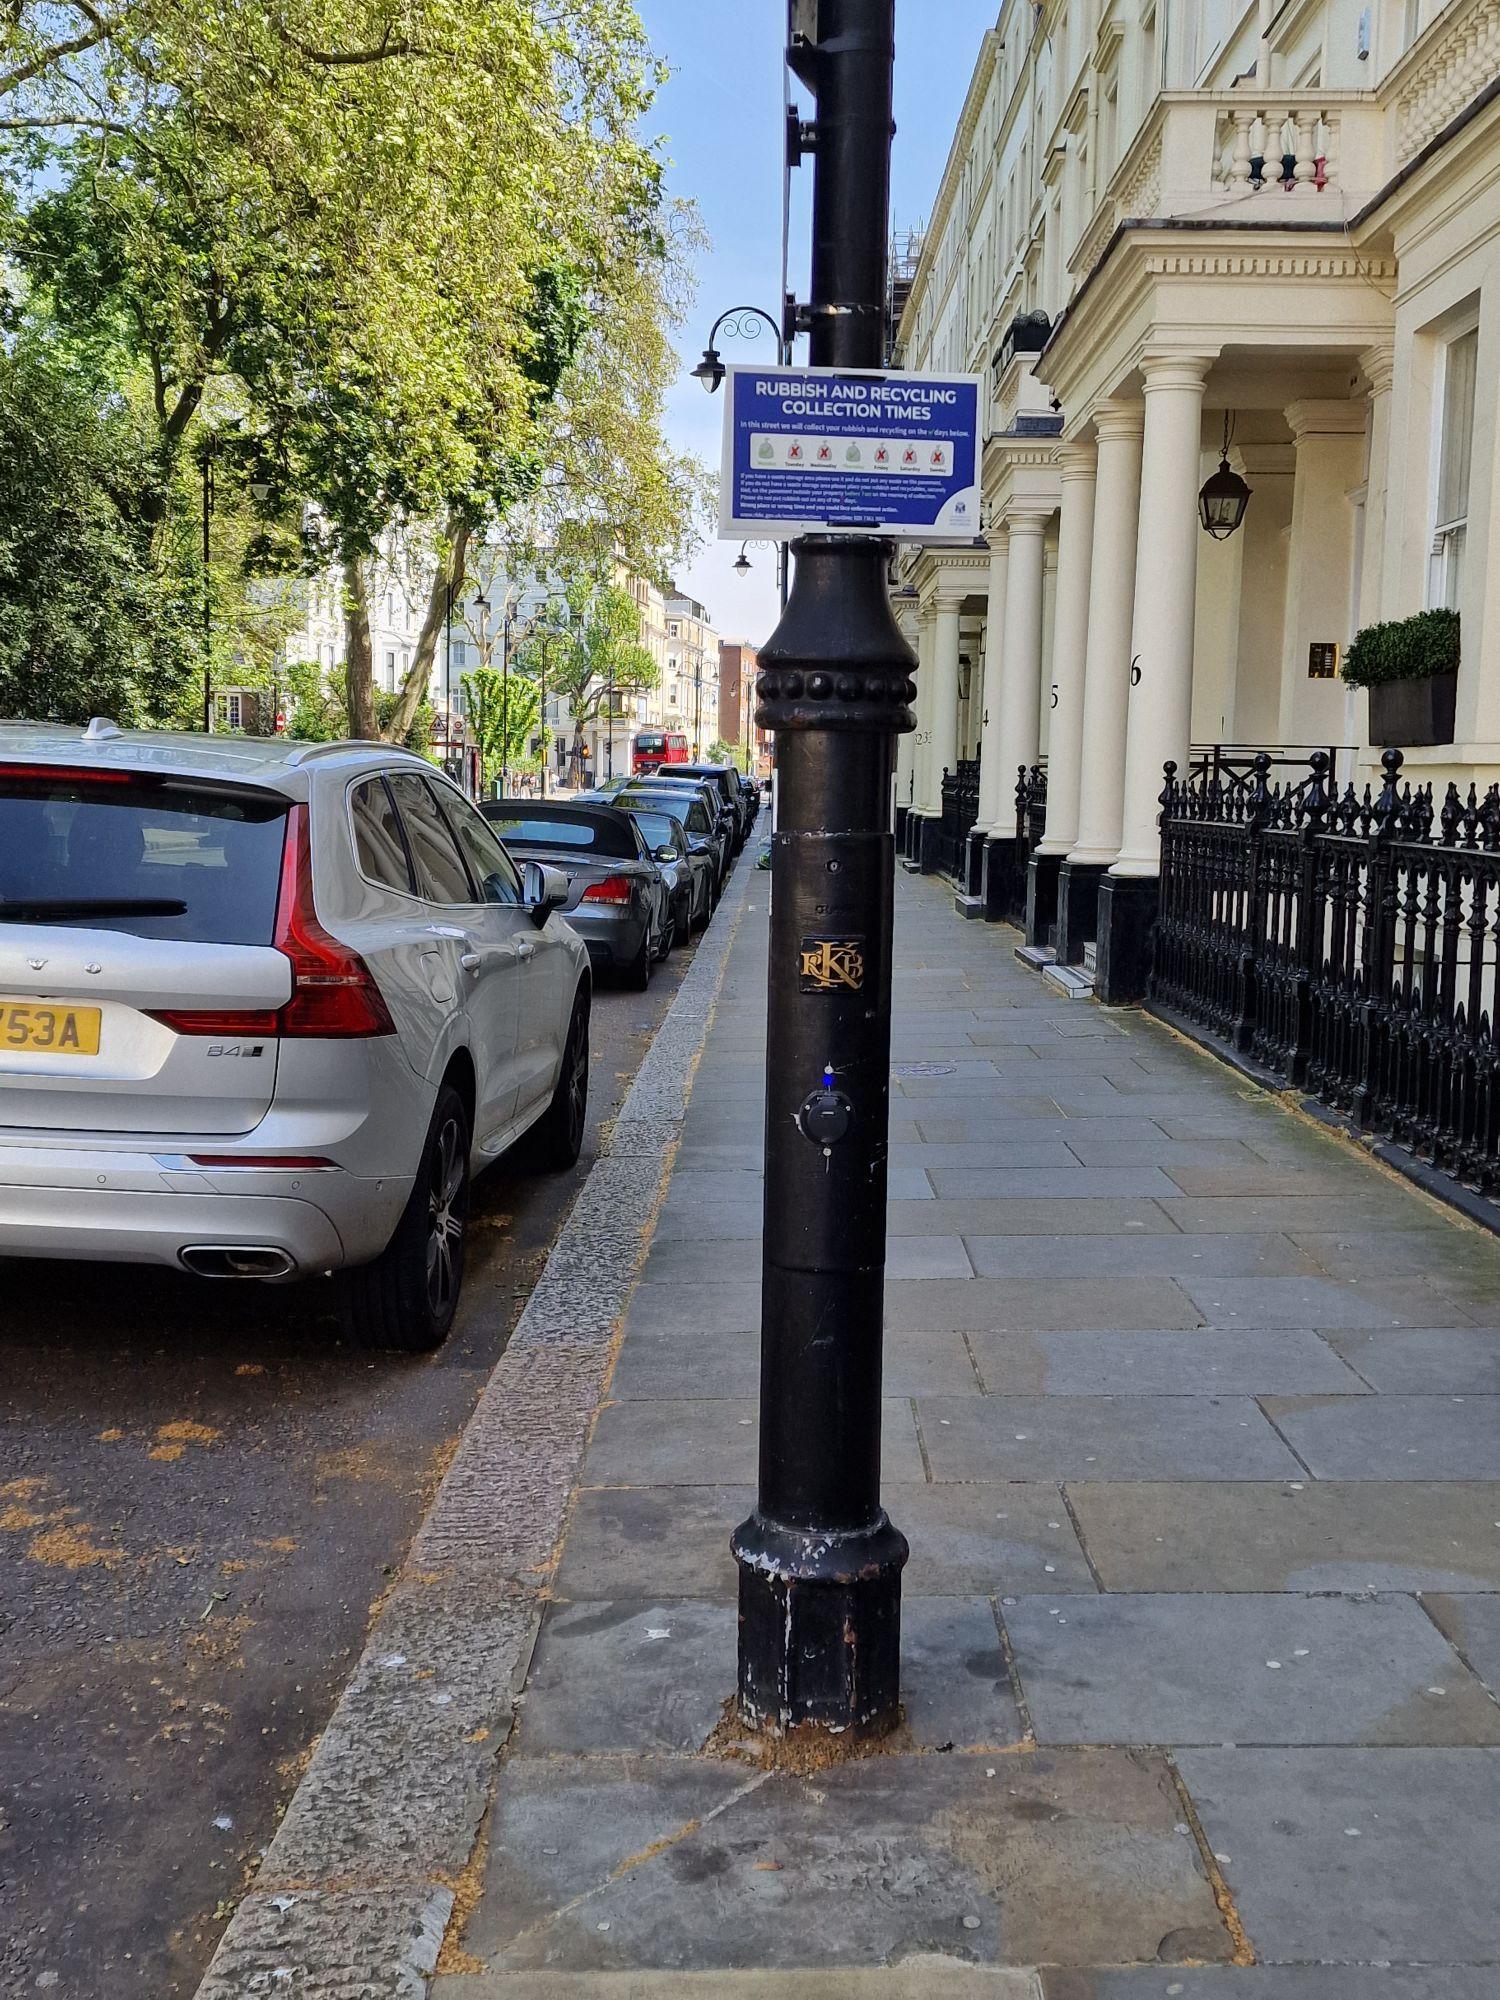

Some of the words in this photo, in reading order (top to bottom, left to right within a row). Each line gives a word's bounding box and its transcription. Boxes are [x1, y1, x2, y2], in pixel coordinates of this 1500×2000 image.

[755, 381, 827, 398] RUBBISH
[830, 384, 866, 399] AND
[870, 386, 956, 404] RECYCLING
[781, 400, 881, 418] COLLECTION
[885, 405, 931, 420] TIMES
[747, 420, 760, 428] this
[761, 420, 779, 429] street
[791, 422, 802, 430] will
[804, 422, 824, 430] collect
[825, 425, 839, 433] your
[841, 424, 865, 432] rubbish
[866, 425, 878, 433] and
[879, 425, 907, 435] recycling
[917, 427, 927, 435] the
[933, 428, 948, 437] days
[1131, 654, 1142, 687] 6
[1051, 684, 1059, 709] 5
[0, 1008, 80, 1048] 53A
